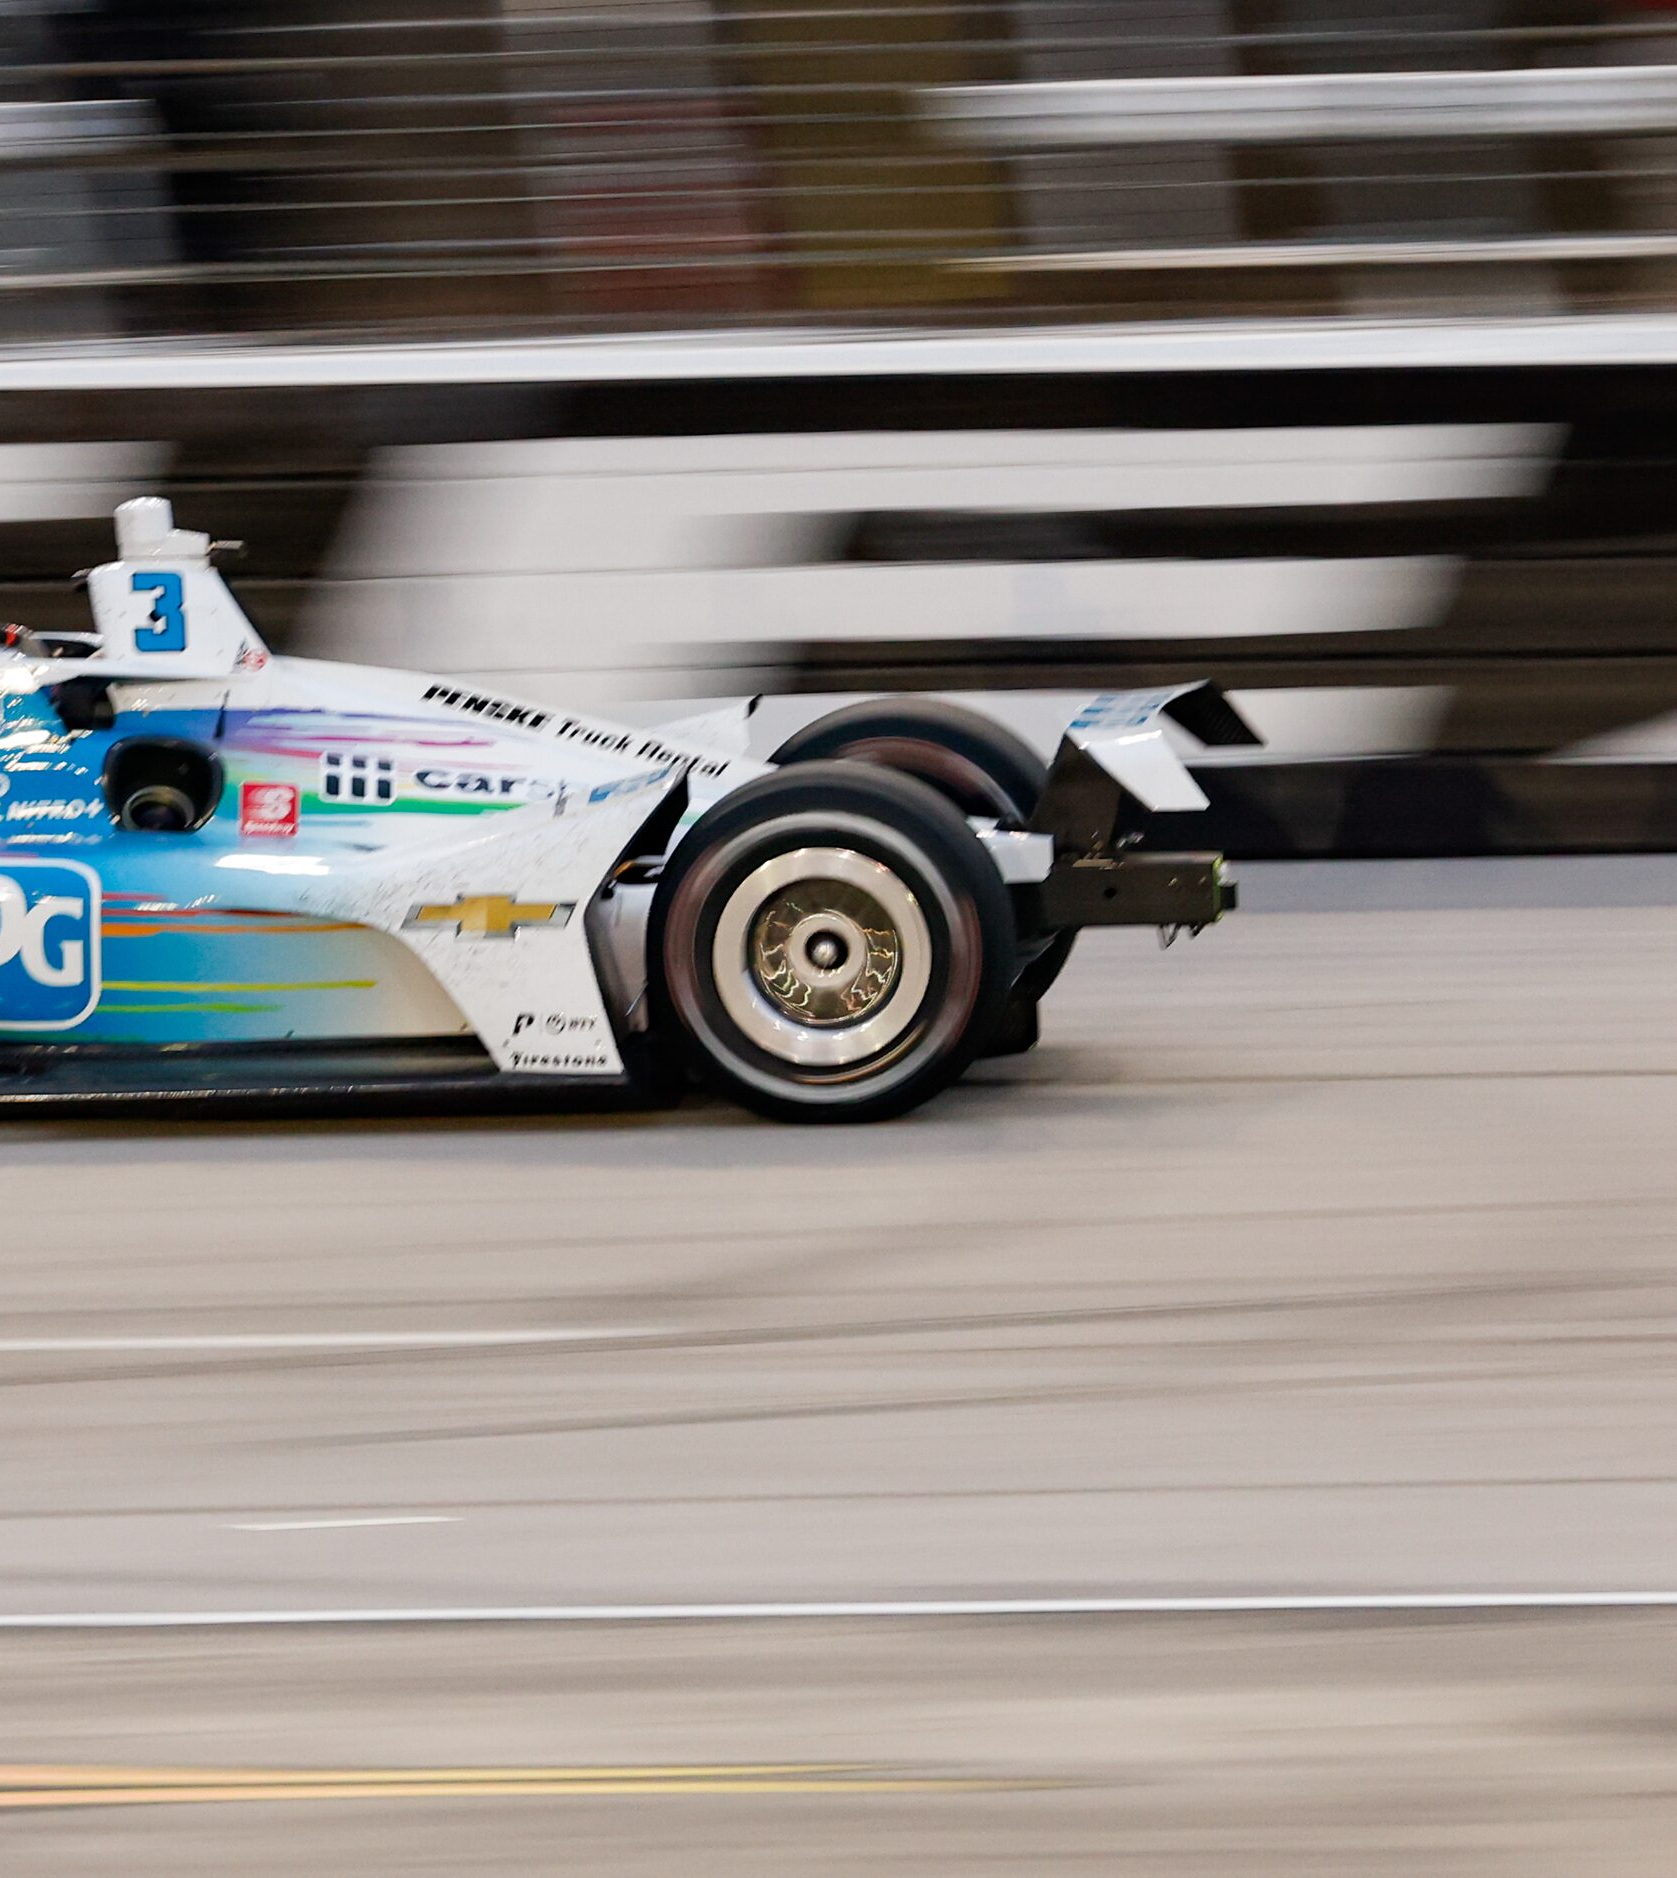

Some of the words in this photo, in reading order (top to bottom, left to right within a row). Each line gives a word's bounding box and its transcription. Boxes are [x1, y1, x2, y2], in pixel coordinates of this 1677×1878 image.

[131, 571, 187, 654] 3
[423, 684, 551, 731] PENSKE
[557, 719, 633, 755] Truck
